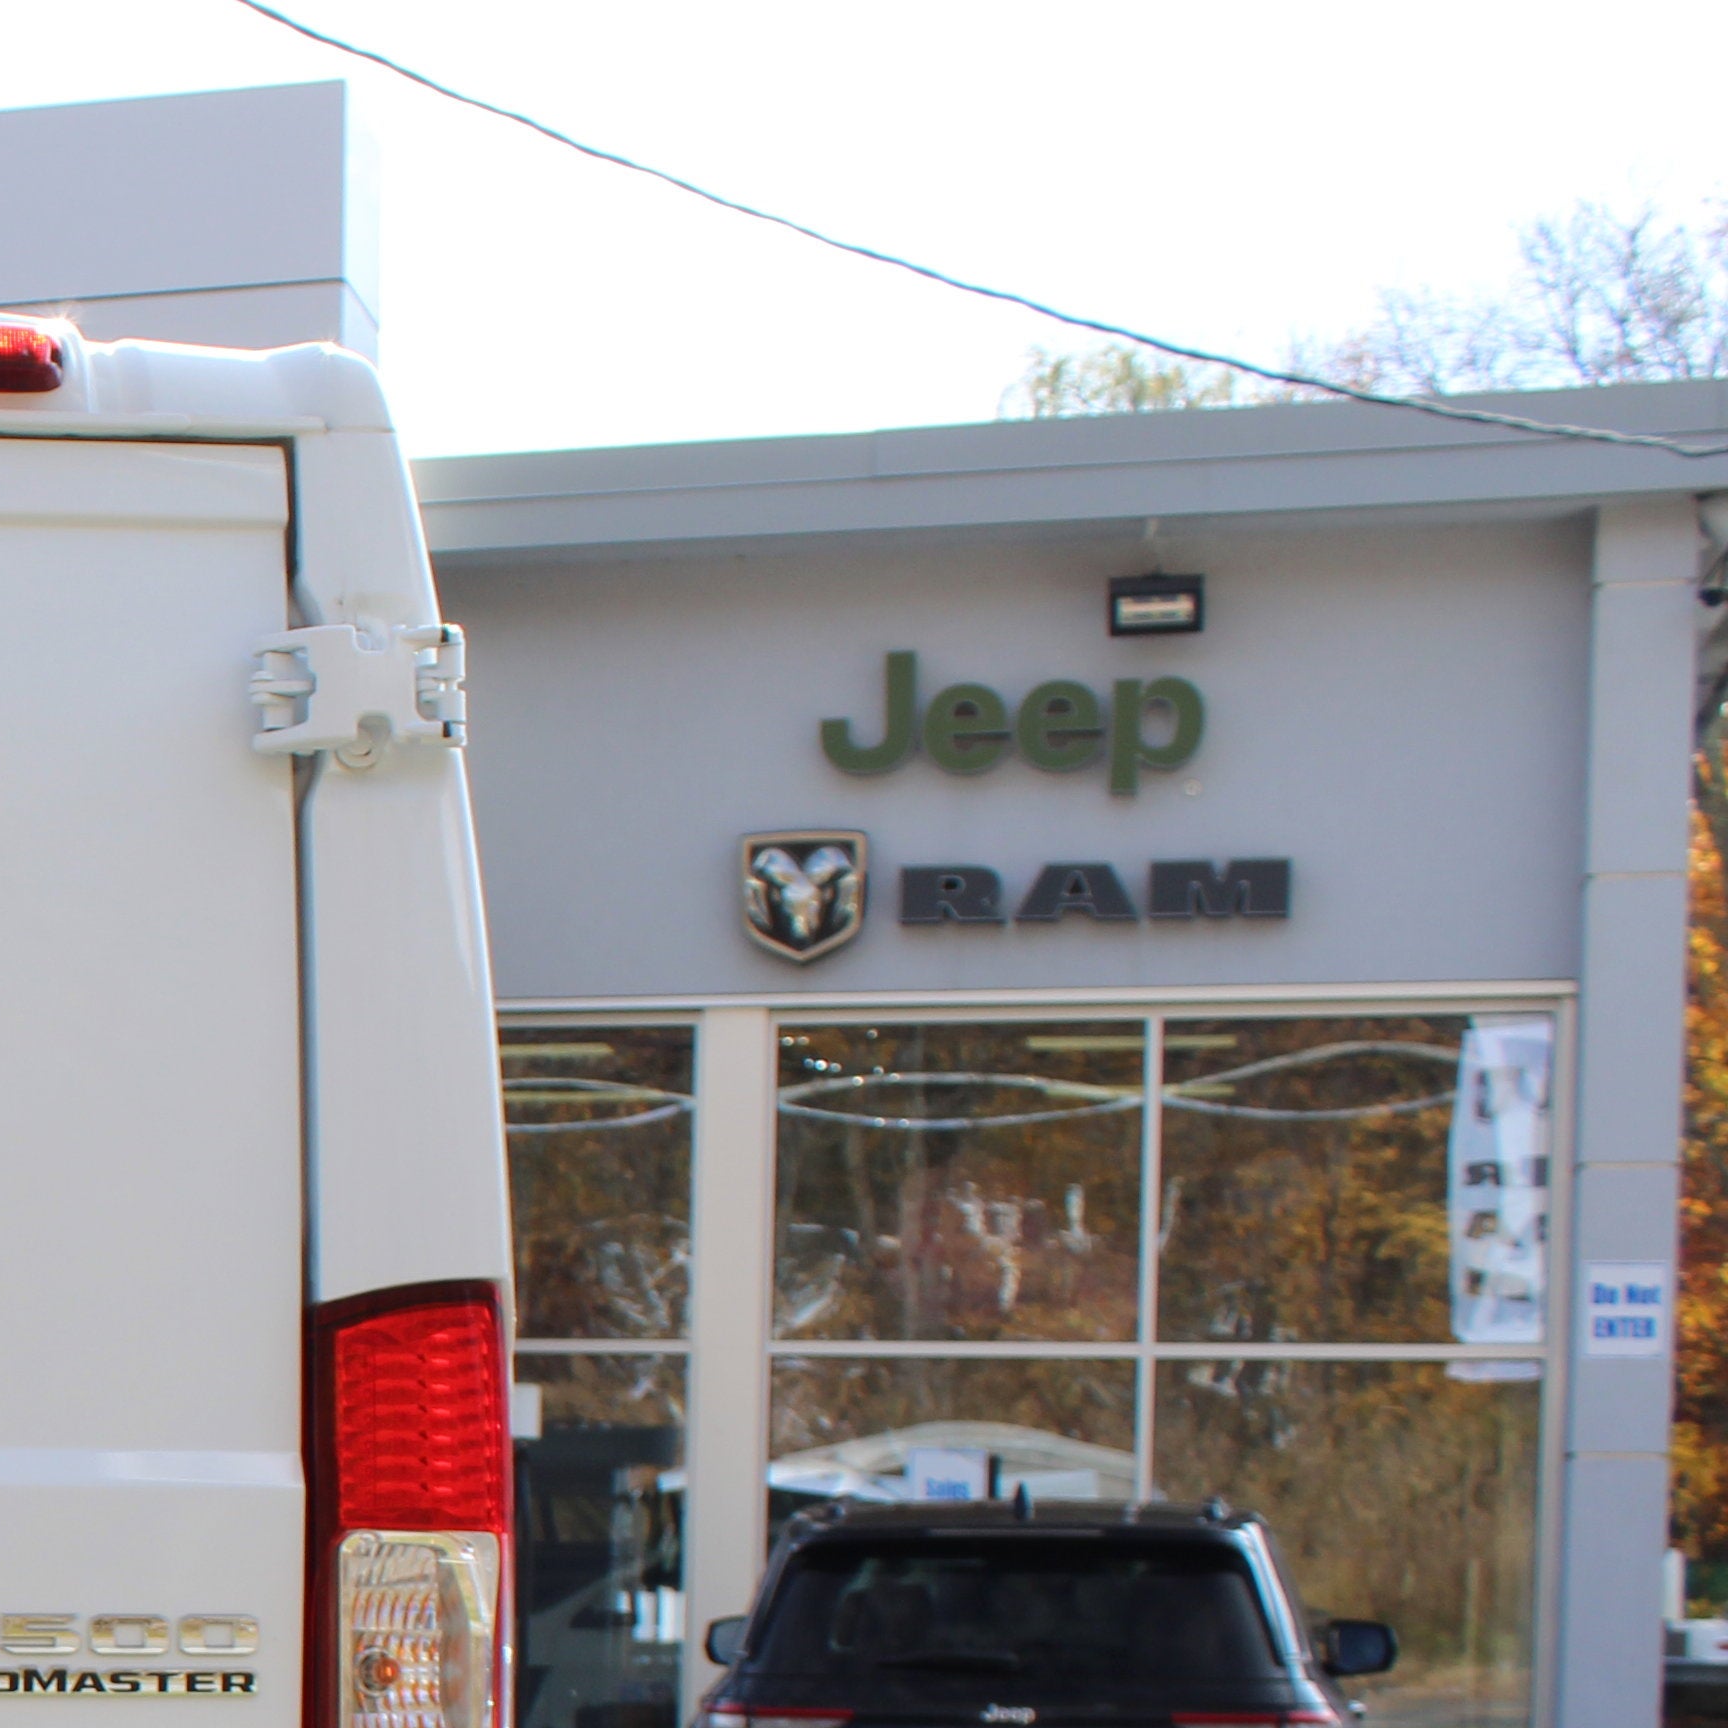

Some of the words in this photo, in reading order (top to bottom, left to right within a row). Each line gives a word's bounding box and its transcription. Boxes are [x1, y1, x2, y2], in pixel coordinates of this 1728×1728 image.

[820, 650, 1205, 796] Jeep
[898, 857, 1293, 925] RAM
[1592, 1282, 1619, 1304] Do
[1625, 1282, 1662, 1304] Not
[1593, 1315, 1657, 1339] ENTER
[979, 1703, 1036, 1724] Jeep
